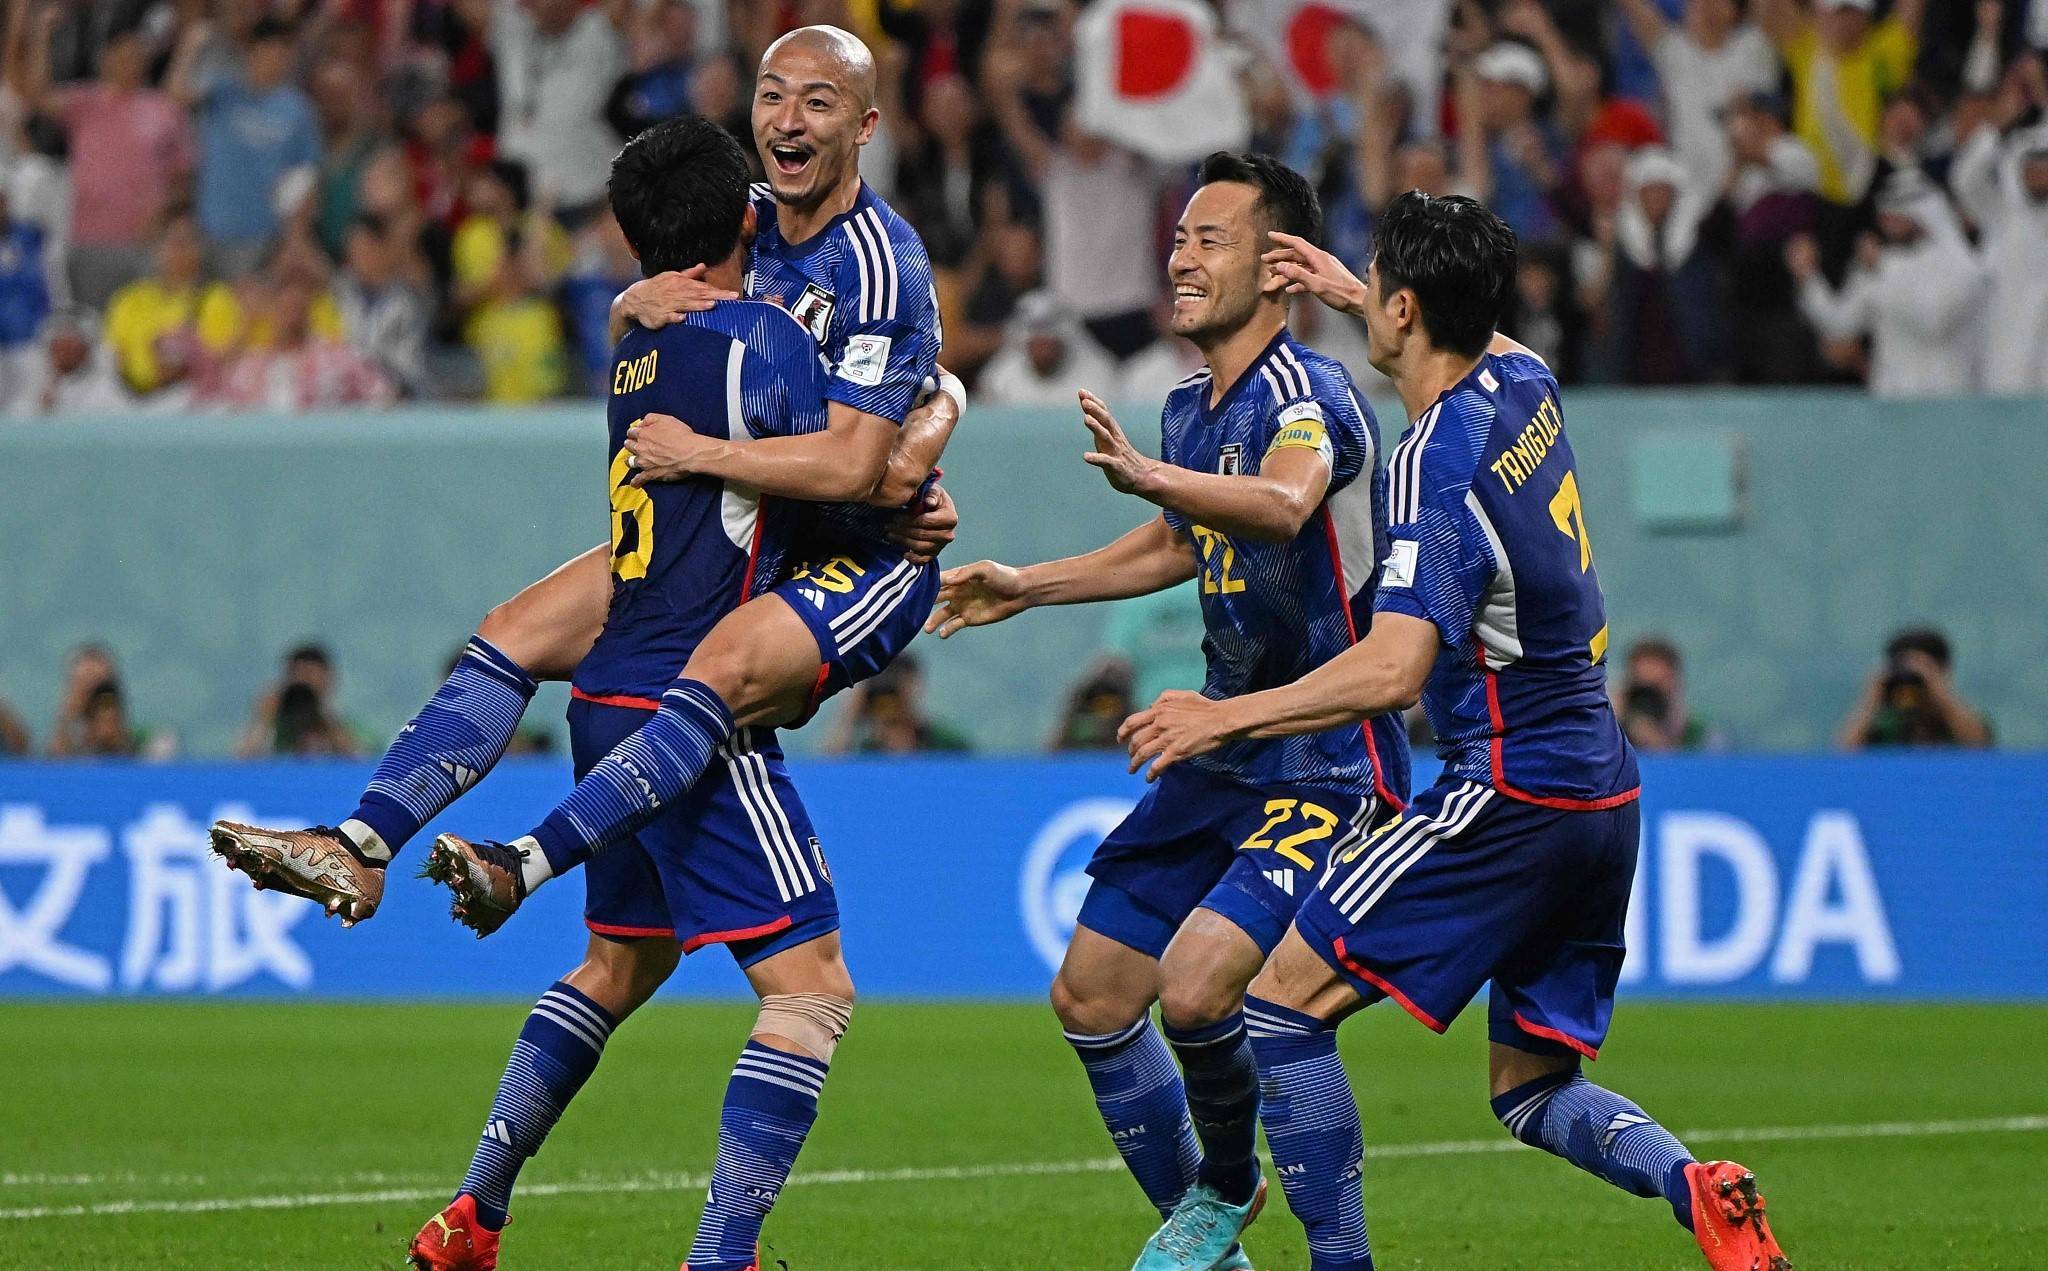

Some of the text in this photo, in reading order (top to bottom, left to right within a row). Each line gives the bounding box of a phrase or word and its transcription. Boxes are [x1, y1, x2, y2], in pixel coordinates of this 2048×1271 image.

[613, 348, 659, 396] ENDO
[609, 417, 654, 582] 6
[1191, 523, 1246, 595] 22
[1238, 798, 1340, 872] 22
